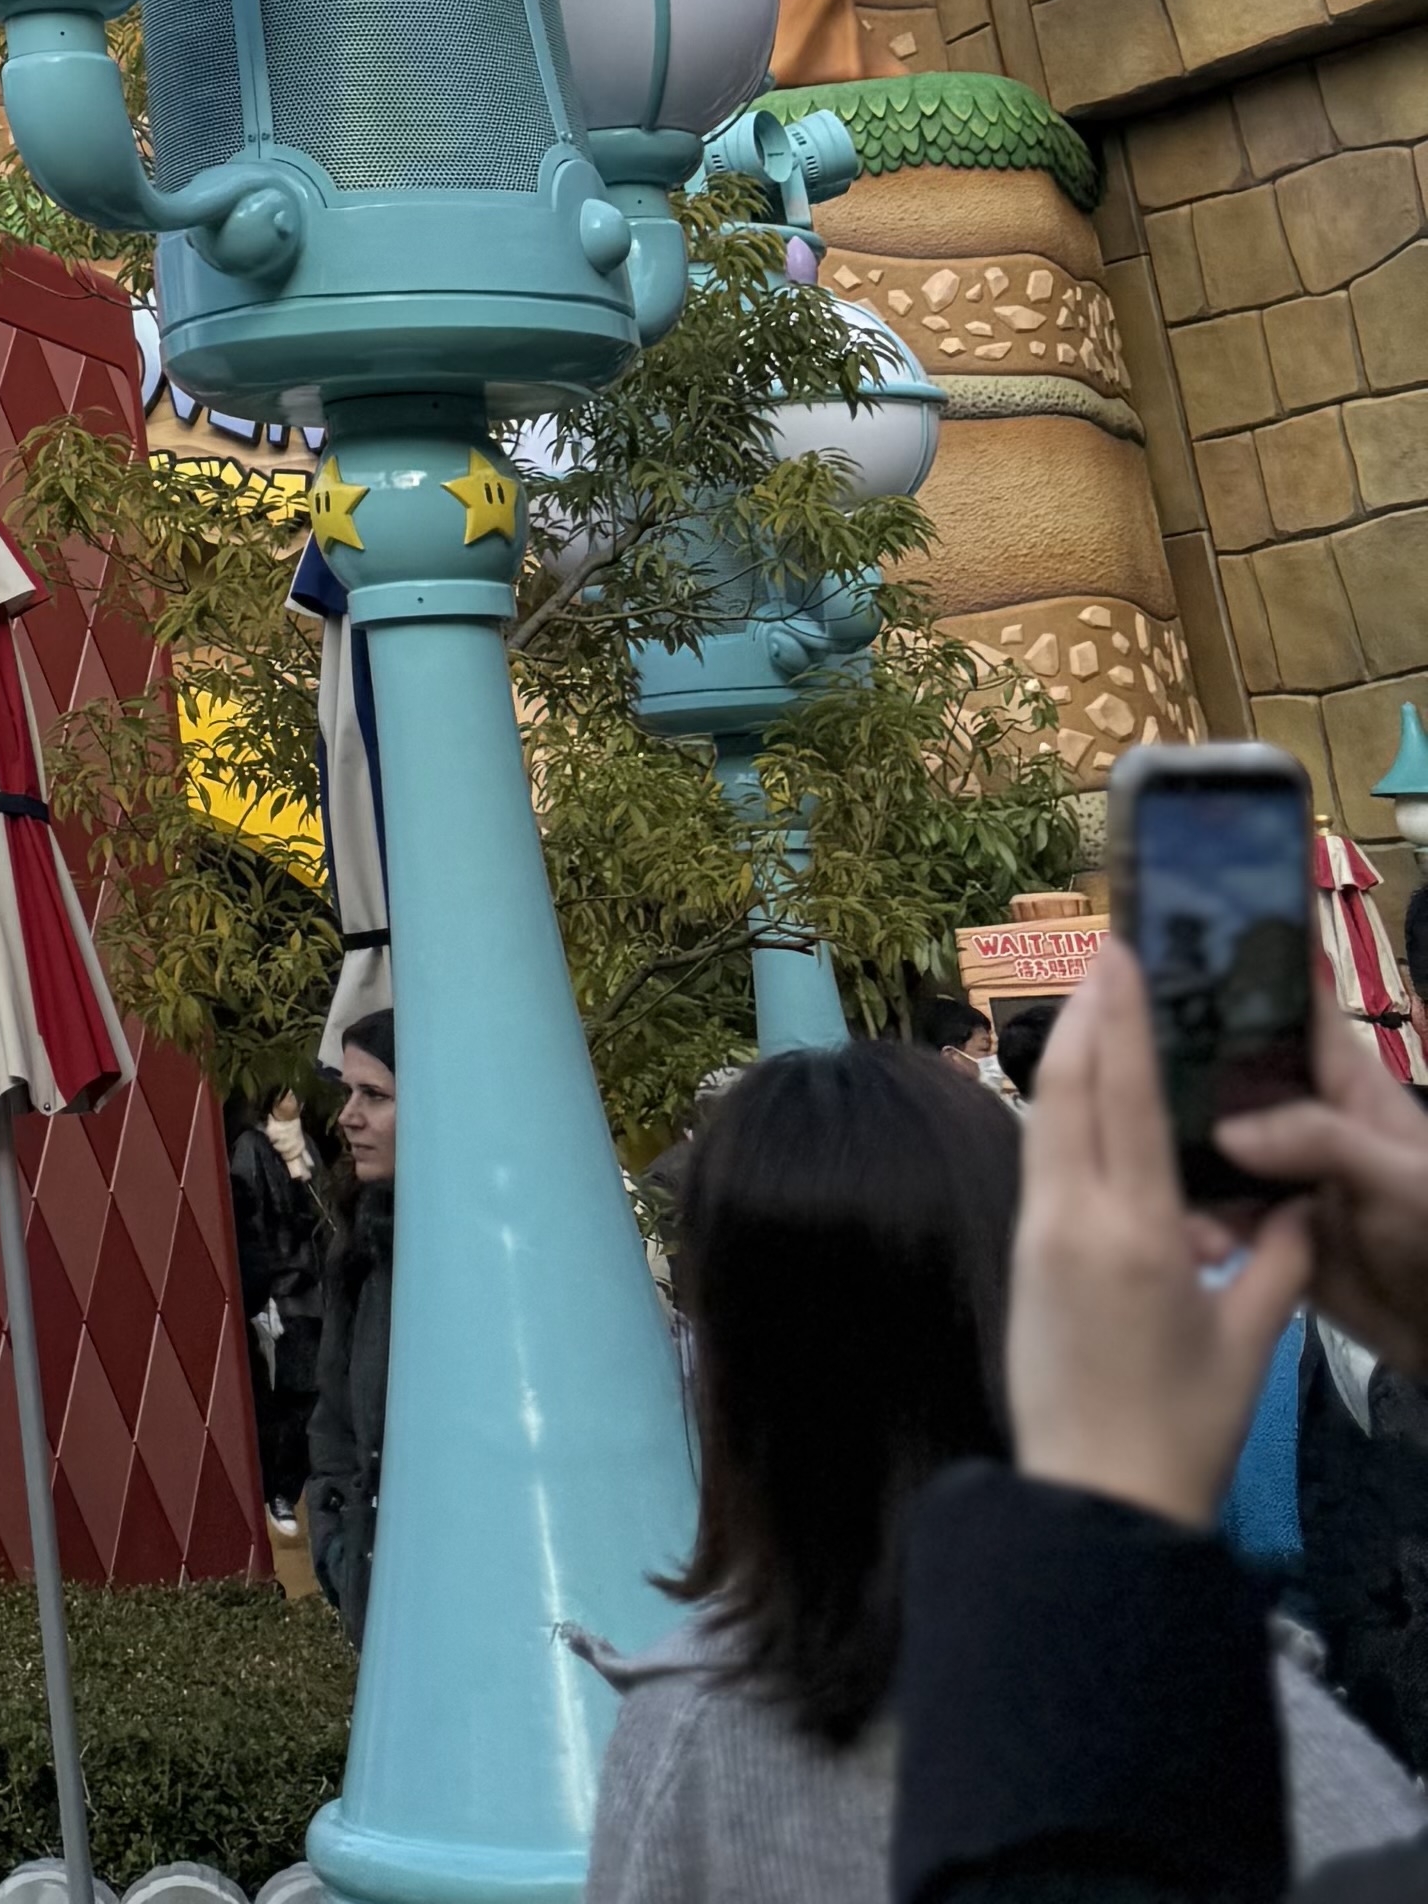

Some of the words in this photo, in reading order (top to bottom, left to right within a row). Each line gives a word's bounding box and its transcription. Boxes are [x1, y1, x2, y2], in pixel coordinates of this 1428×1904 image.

[971, 931, 1044, 959] WAIT
[1014, 957, 1089, 981] 待ち時間
